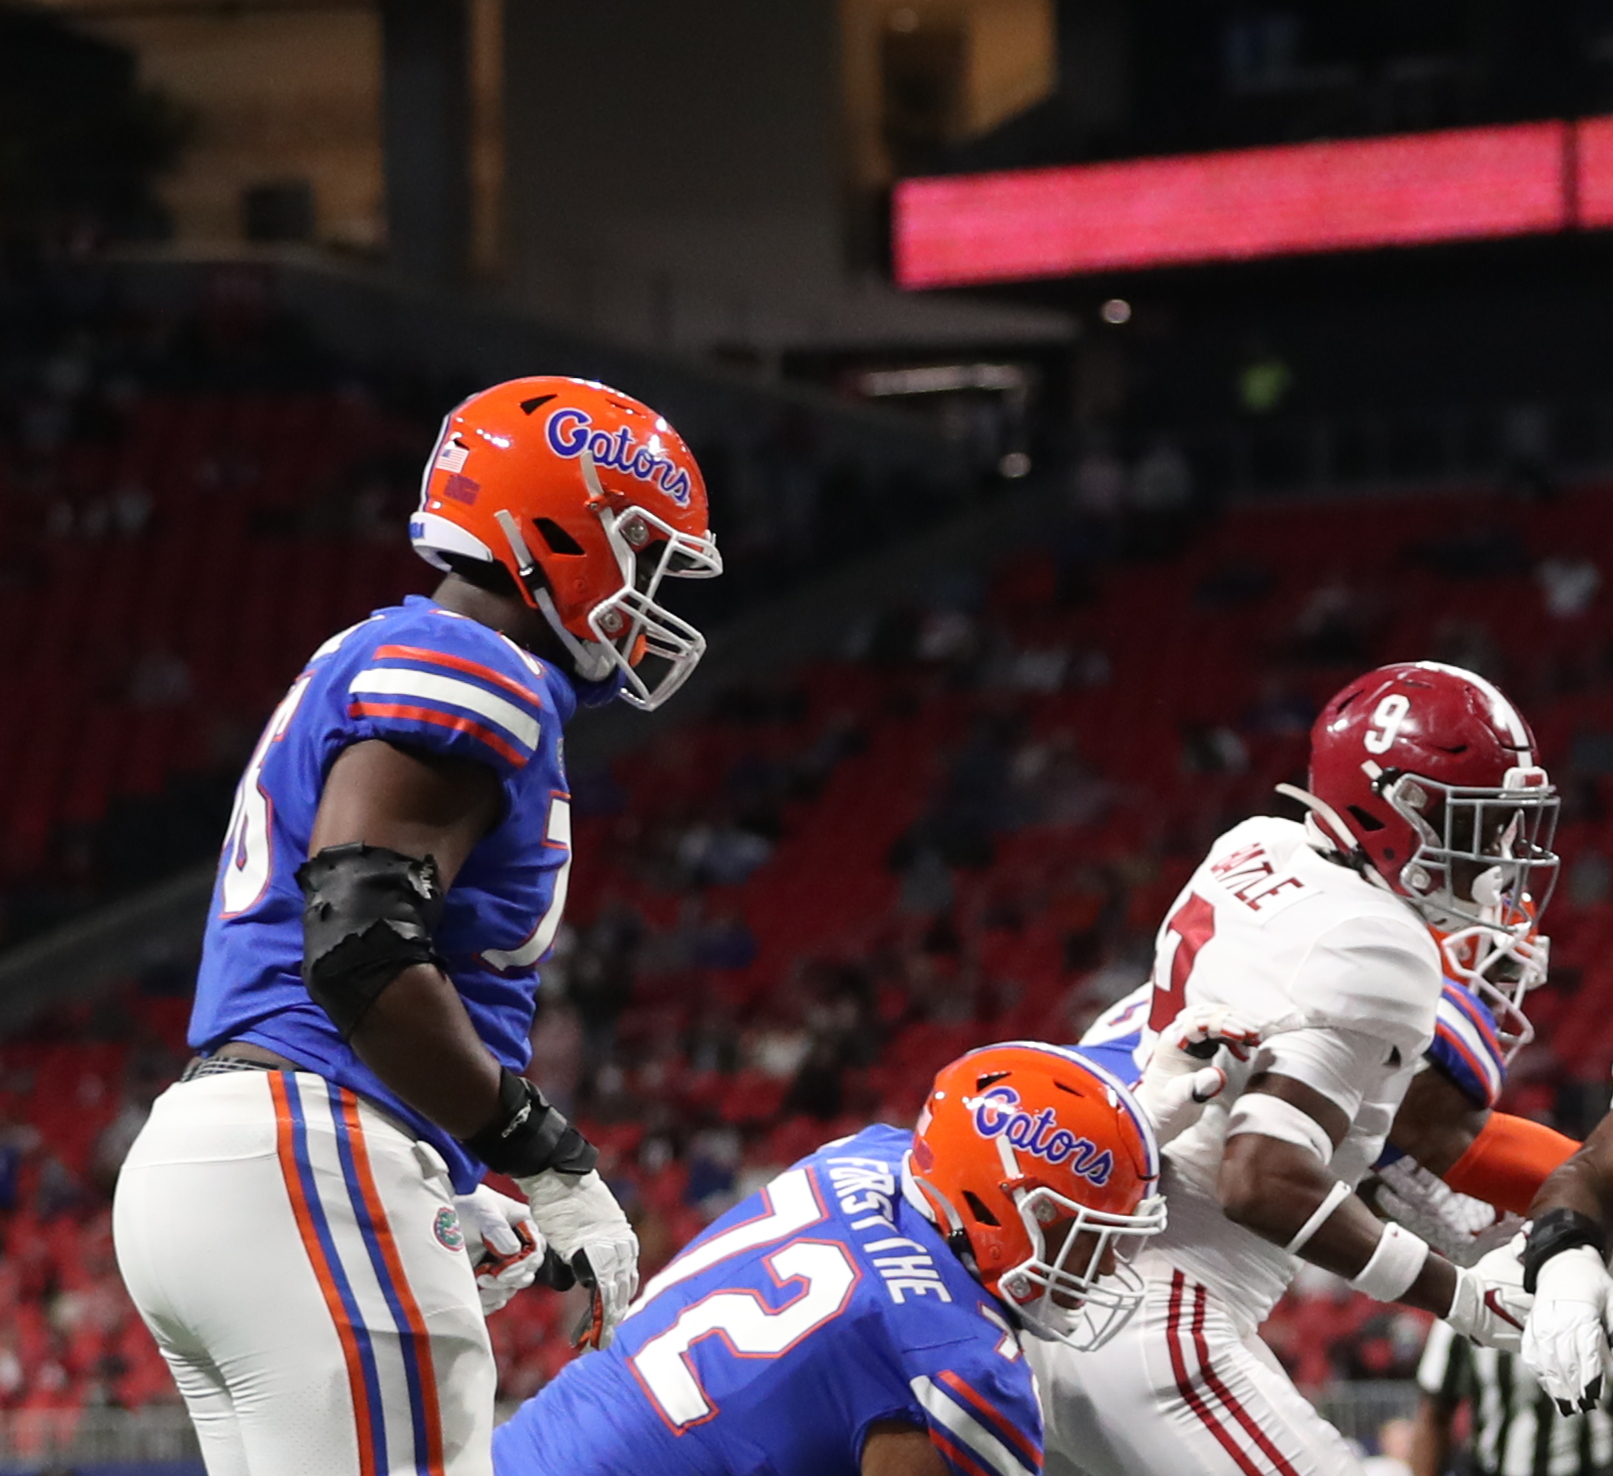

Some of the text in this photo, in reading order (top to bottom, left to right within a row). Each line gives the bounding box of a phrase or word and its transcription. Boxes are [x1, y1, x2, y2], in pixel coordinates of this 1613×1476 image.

[545, 406, 692, 508] Gators
[1363, 693, 1411, 755] 9
[972, 1086, 1115, 1187] Gators
[612, 1164, 863, 1438] 72
